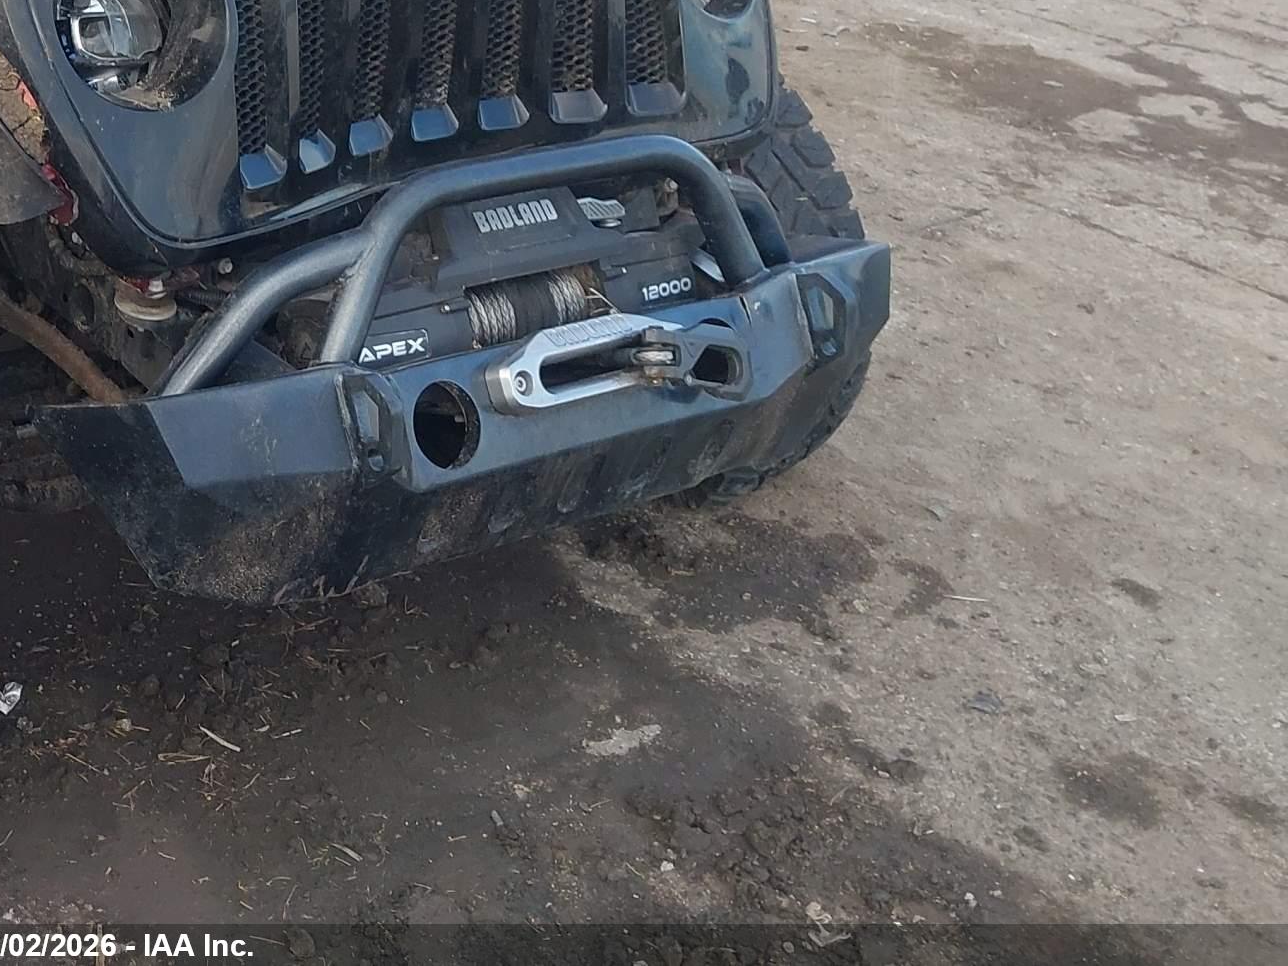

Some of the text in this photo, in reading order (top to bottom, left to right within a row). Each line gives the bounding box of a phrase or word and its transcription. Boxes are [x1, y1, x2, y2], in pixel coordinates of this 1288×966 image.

[473, 198, 559, 233] BADLAND
[641, 277, 692, 302] 12000
[358, 337, 426, 364] APEX
